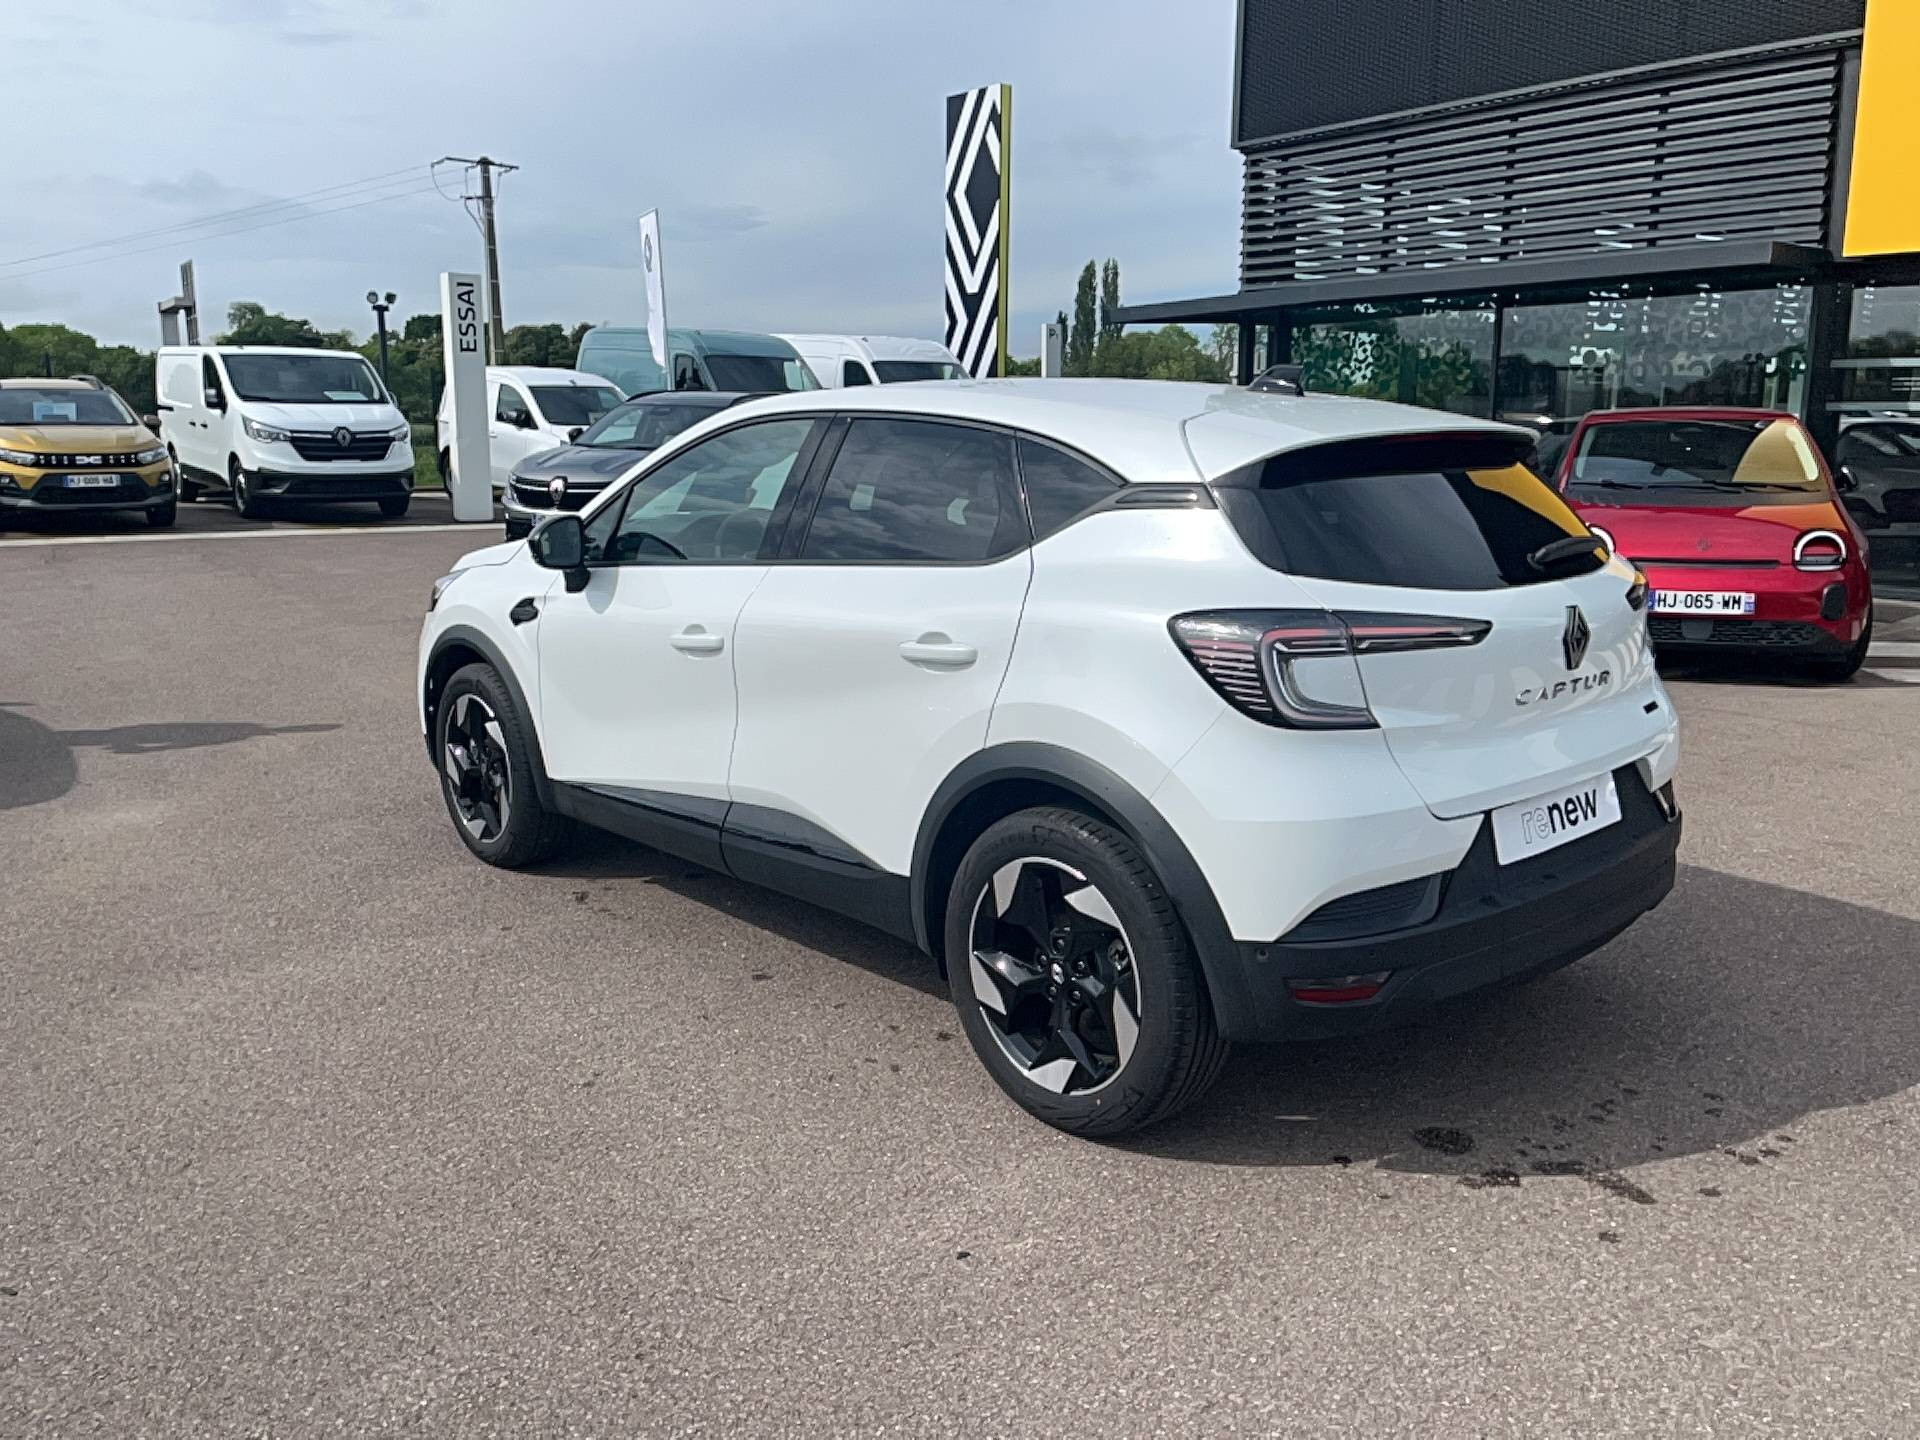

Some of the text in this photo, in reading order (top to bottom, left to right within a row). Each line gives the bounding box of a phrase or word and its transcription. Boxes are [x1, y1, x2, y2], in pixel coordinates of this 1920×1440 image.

[456, 282, 477, 352] ESSAI
[1515, 670, 1610, 706] CAPTUR
[1521, 789, 1597, 844] renew
